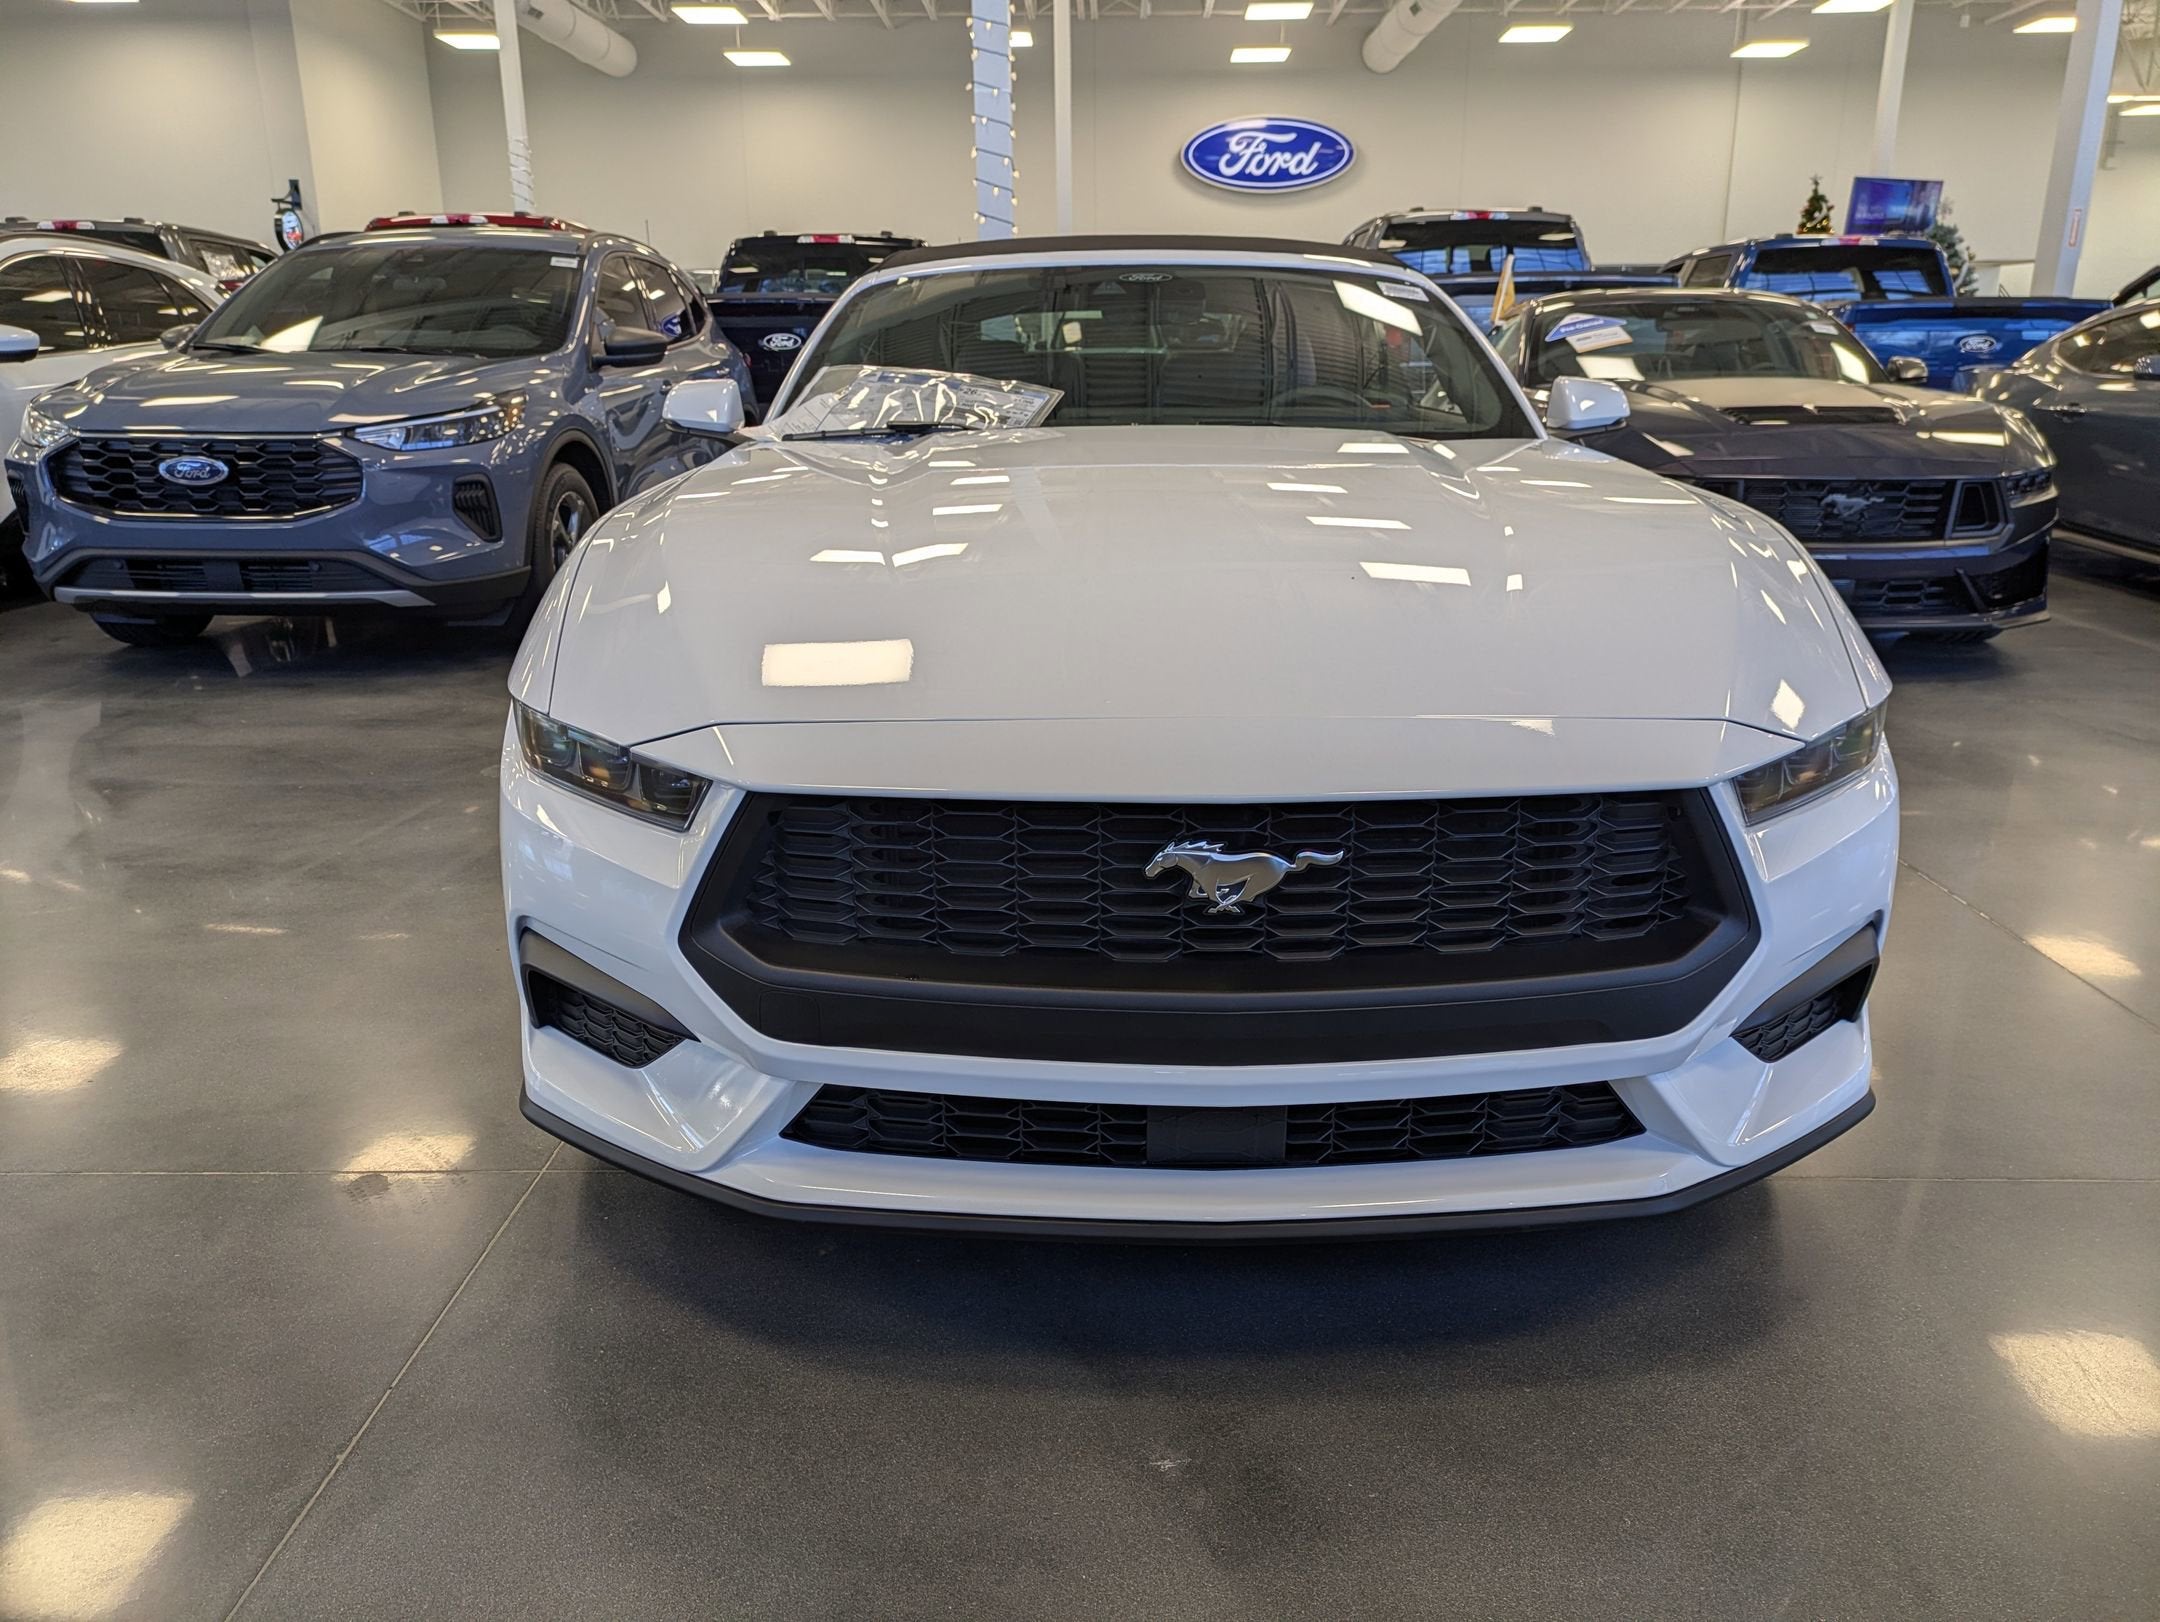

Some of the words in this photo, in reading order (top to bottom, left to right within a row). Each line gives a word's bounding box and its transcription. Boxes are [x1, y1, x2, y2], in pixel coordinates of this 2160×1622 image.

[1218, 131, 1322, 176] Ford
[1129, 272, 1162, 281] Ford
[770, 336, 795, 347] Ford
[1966, 338, 1991, 351] Ford
[174, 462, 210, 478] Ford
